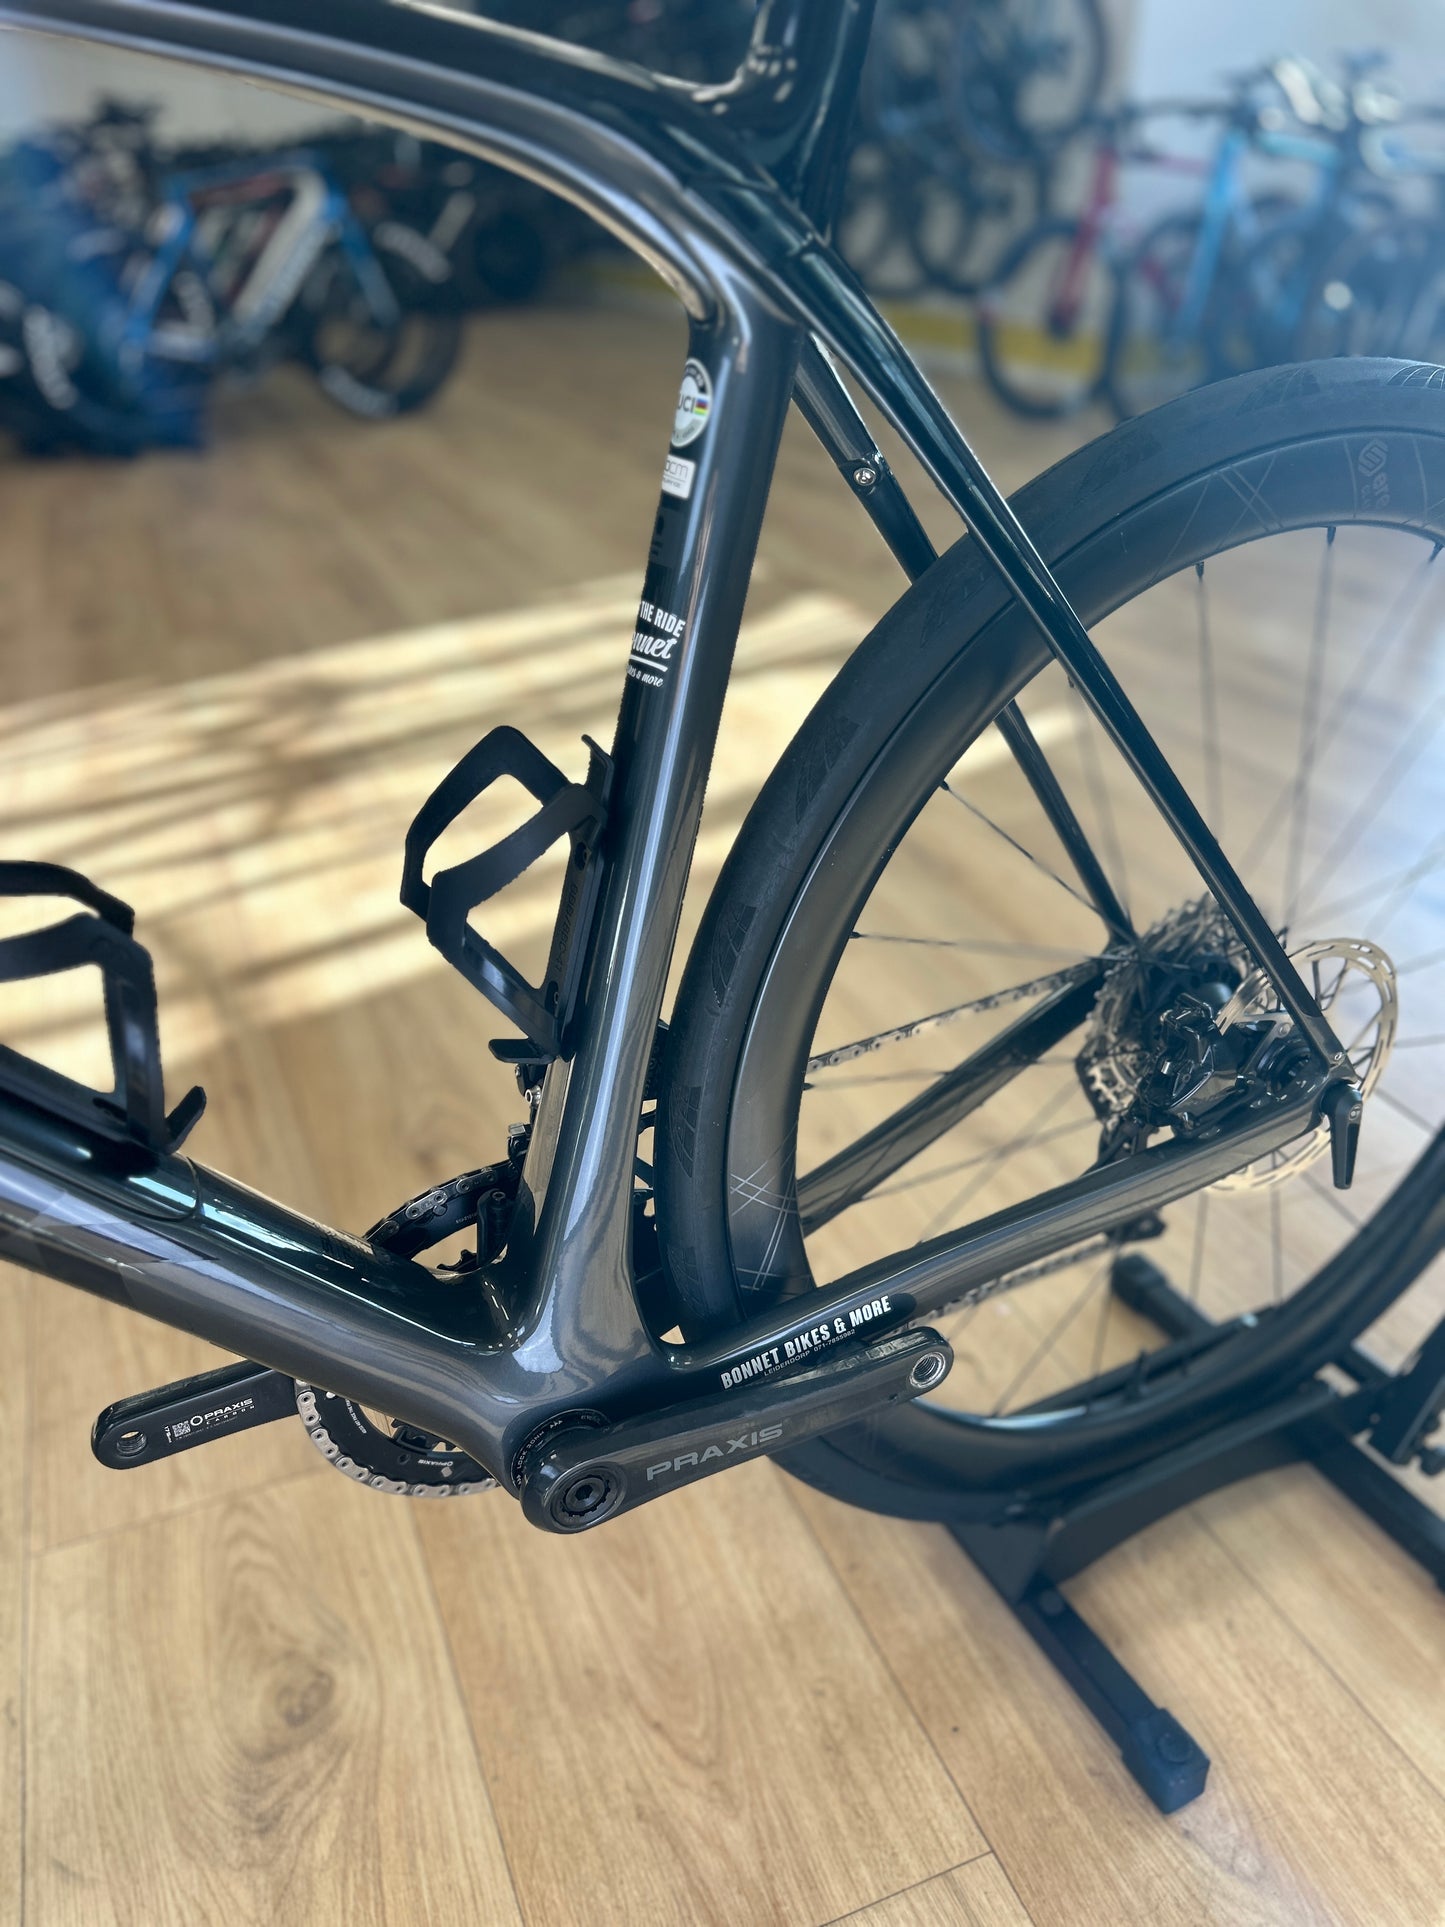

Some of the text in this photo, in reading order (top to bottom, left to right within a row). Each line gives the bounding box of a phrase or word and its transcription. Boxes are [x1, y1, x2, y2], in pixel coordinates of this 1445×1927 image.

[640, 600, 687, 638] THE RIDE
[641, 673, 664, 688] more
[720, 1295, 892, 1390] BONNET BIKES & MORE
[763, 1350, 810, 1377] LEIDERDORP
[204, 1398, 253, 1420] PRAXIS
[646, 1423, 783, 1481] PRAXIS
